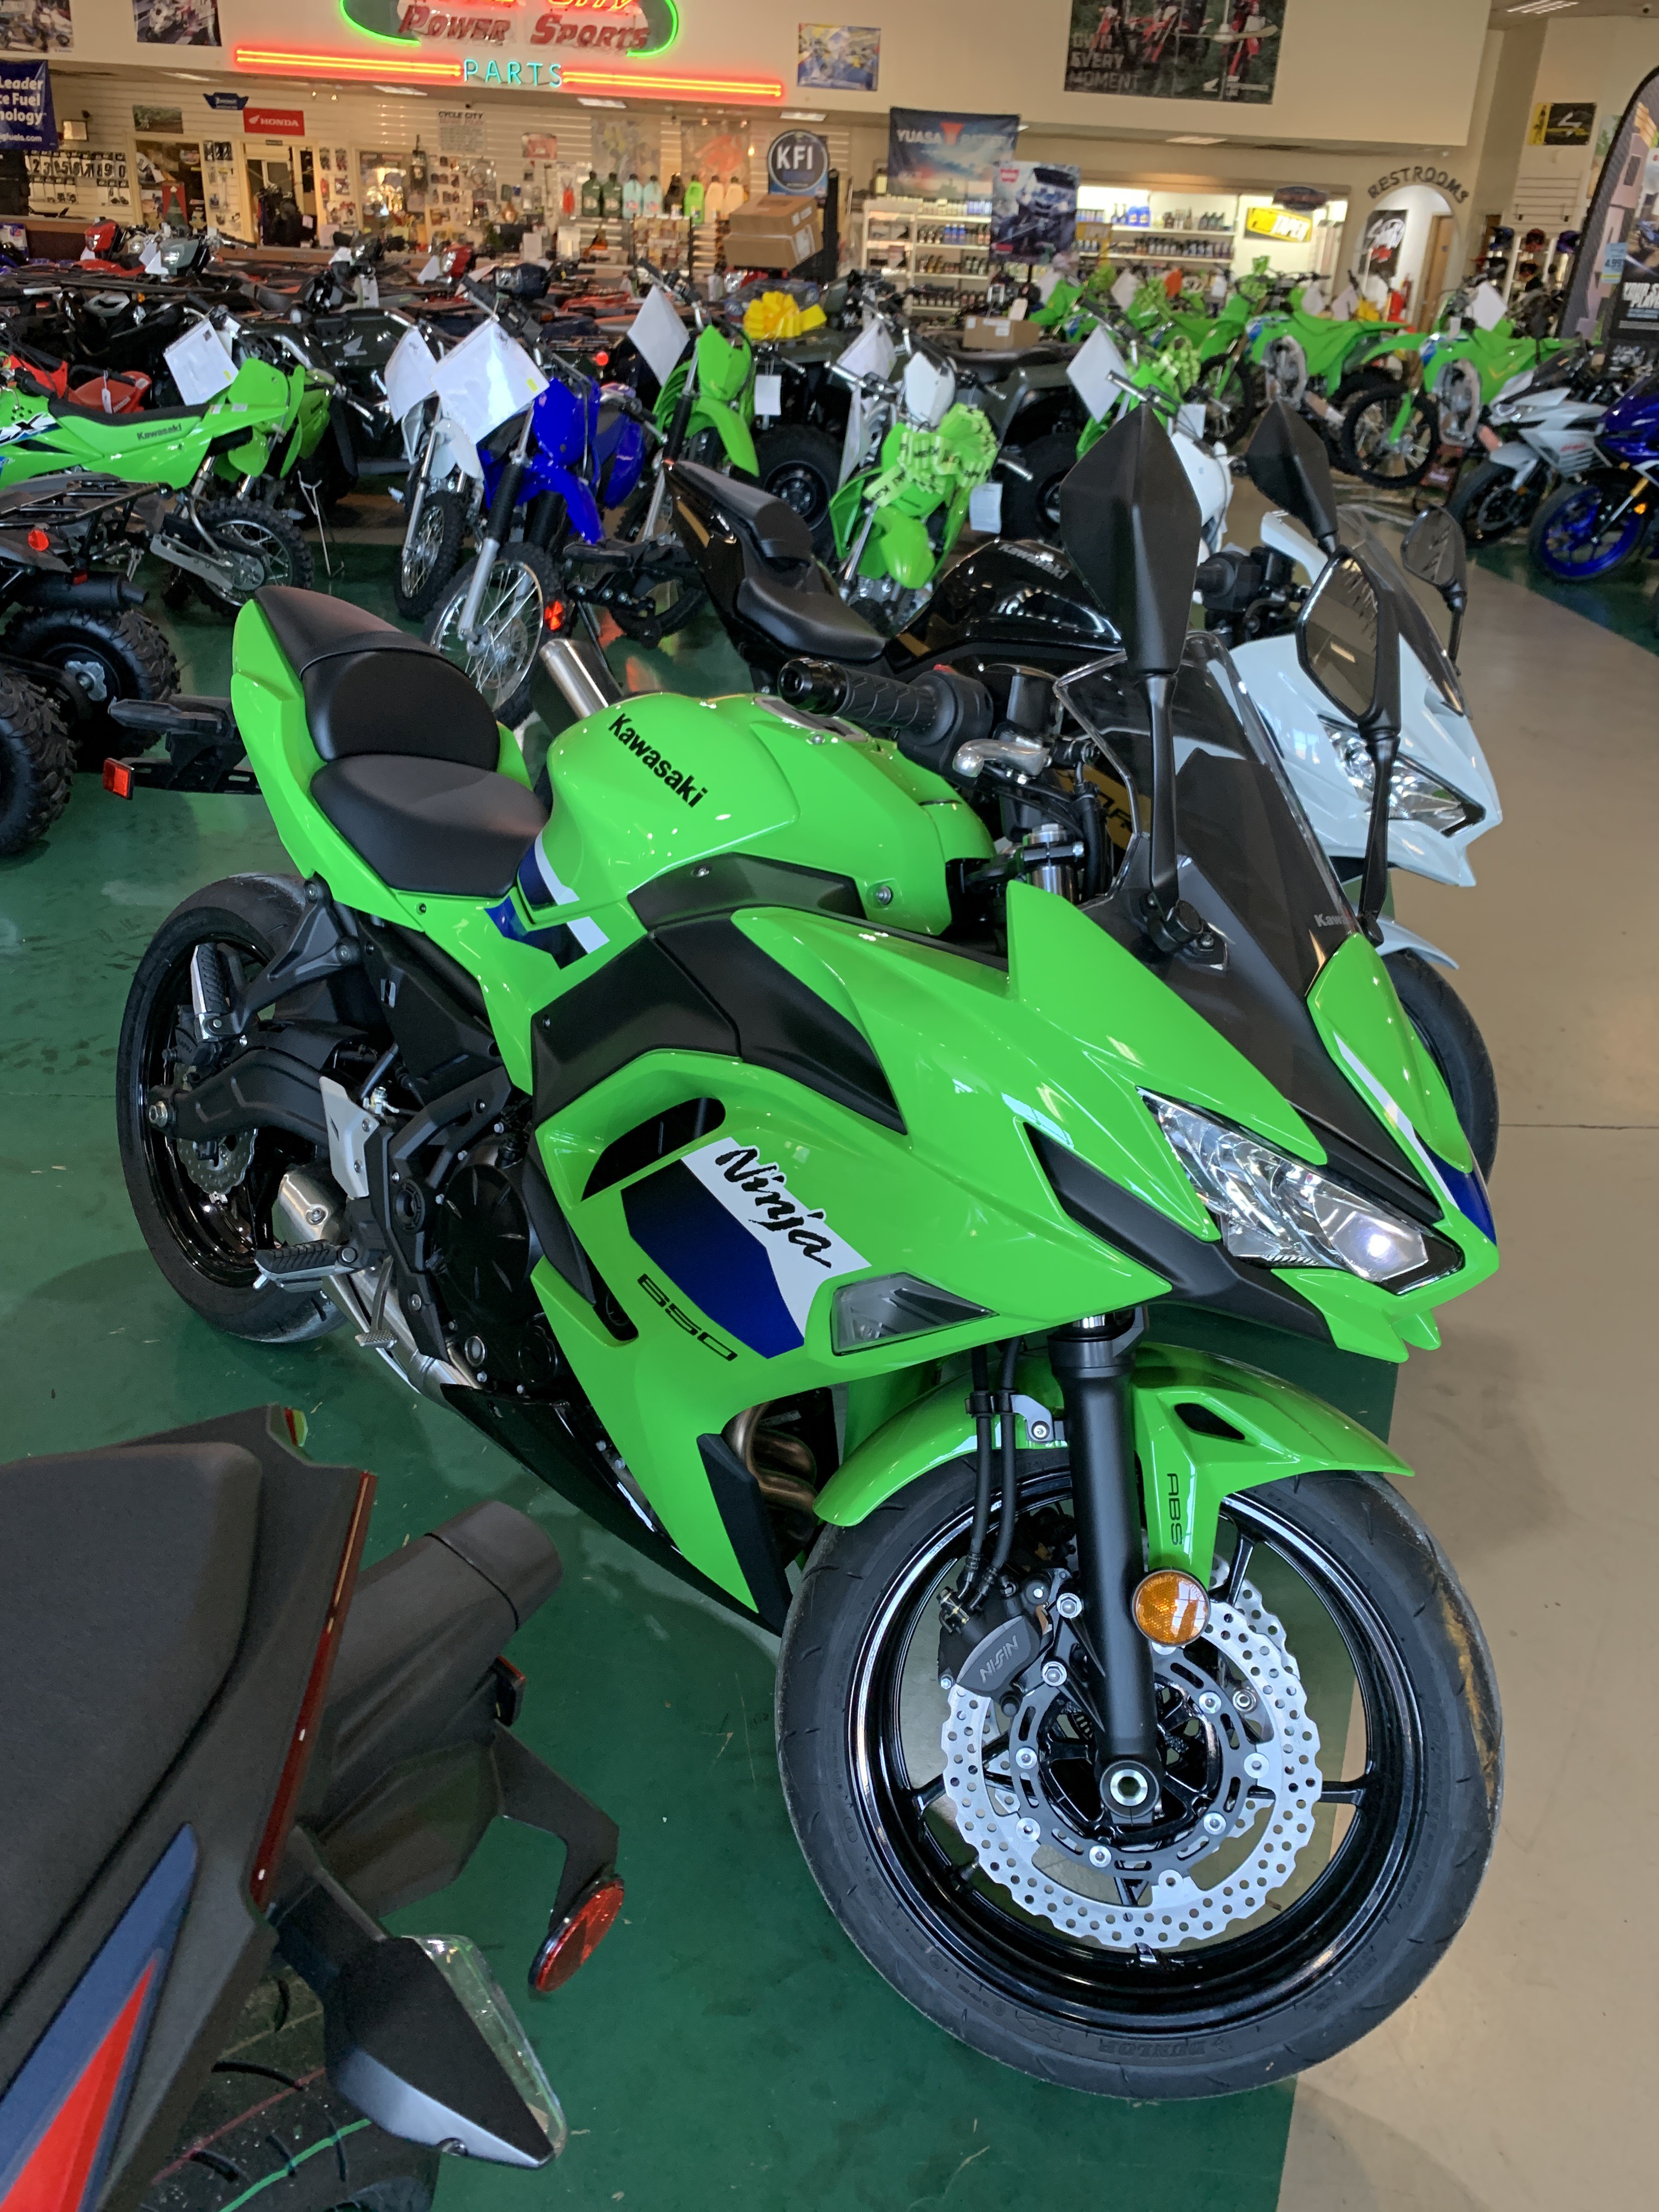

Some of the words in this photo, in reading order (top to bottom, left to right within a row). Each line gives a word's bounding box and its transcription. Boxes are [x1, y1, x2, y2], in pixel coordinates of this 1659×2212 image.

[398, 5, 512, 46] POWER
[530, 13, 651, 48] SPORTS
[464, 59, 562, 87] PARTS
[12, 92, 41, 106] Fuel
[260, 117, 299, 127] HONDA
[896, 129, 943, 144] YUASA
[776, 145, 813, 170] KFI
[1368, 166, 1470, 204] RESTROOMS
[608, 713, 709, 808] Kawasaki
[715, 1148, 832, 1269] Ninja
[637, 1273, 738, 1362] 650
[1166, 1472, 1183, 1547] ABS
